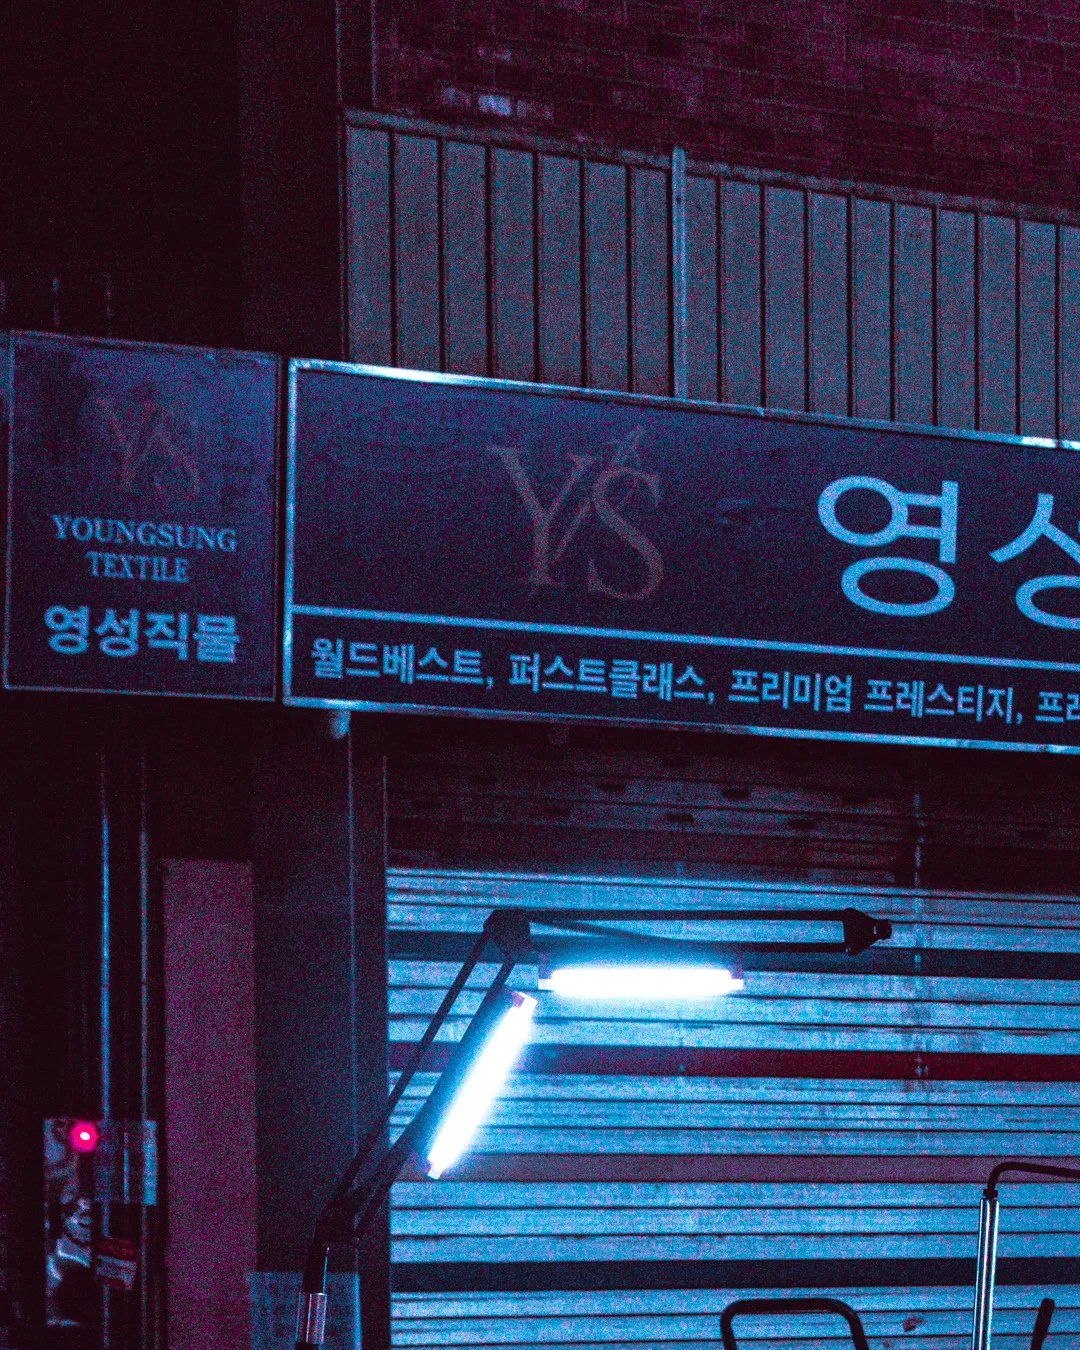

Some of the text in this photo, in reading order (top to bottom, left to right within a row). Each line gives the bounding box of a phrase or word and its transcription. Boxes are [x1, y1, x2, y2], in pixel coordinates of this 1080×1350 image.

[52, 514, 238, 553] YOUNGSUNG
[85, 551, 190, 583] TEXTILE
[44, 604, 241, 663] 영성직물
[310, 637, 495, 689] 월드베스트,
[508, 652, 715, 704] 퍼스트클래스,
[727, 668, 853, 714] 프리미엄
[863, 678, 1023, 725] 프레스티지,
